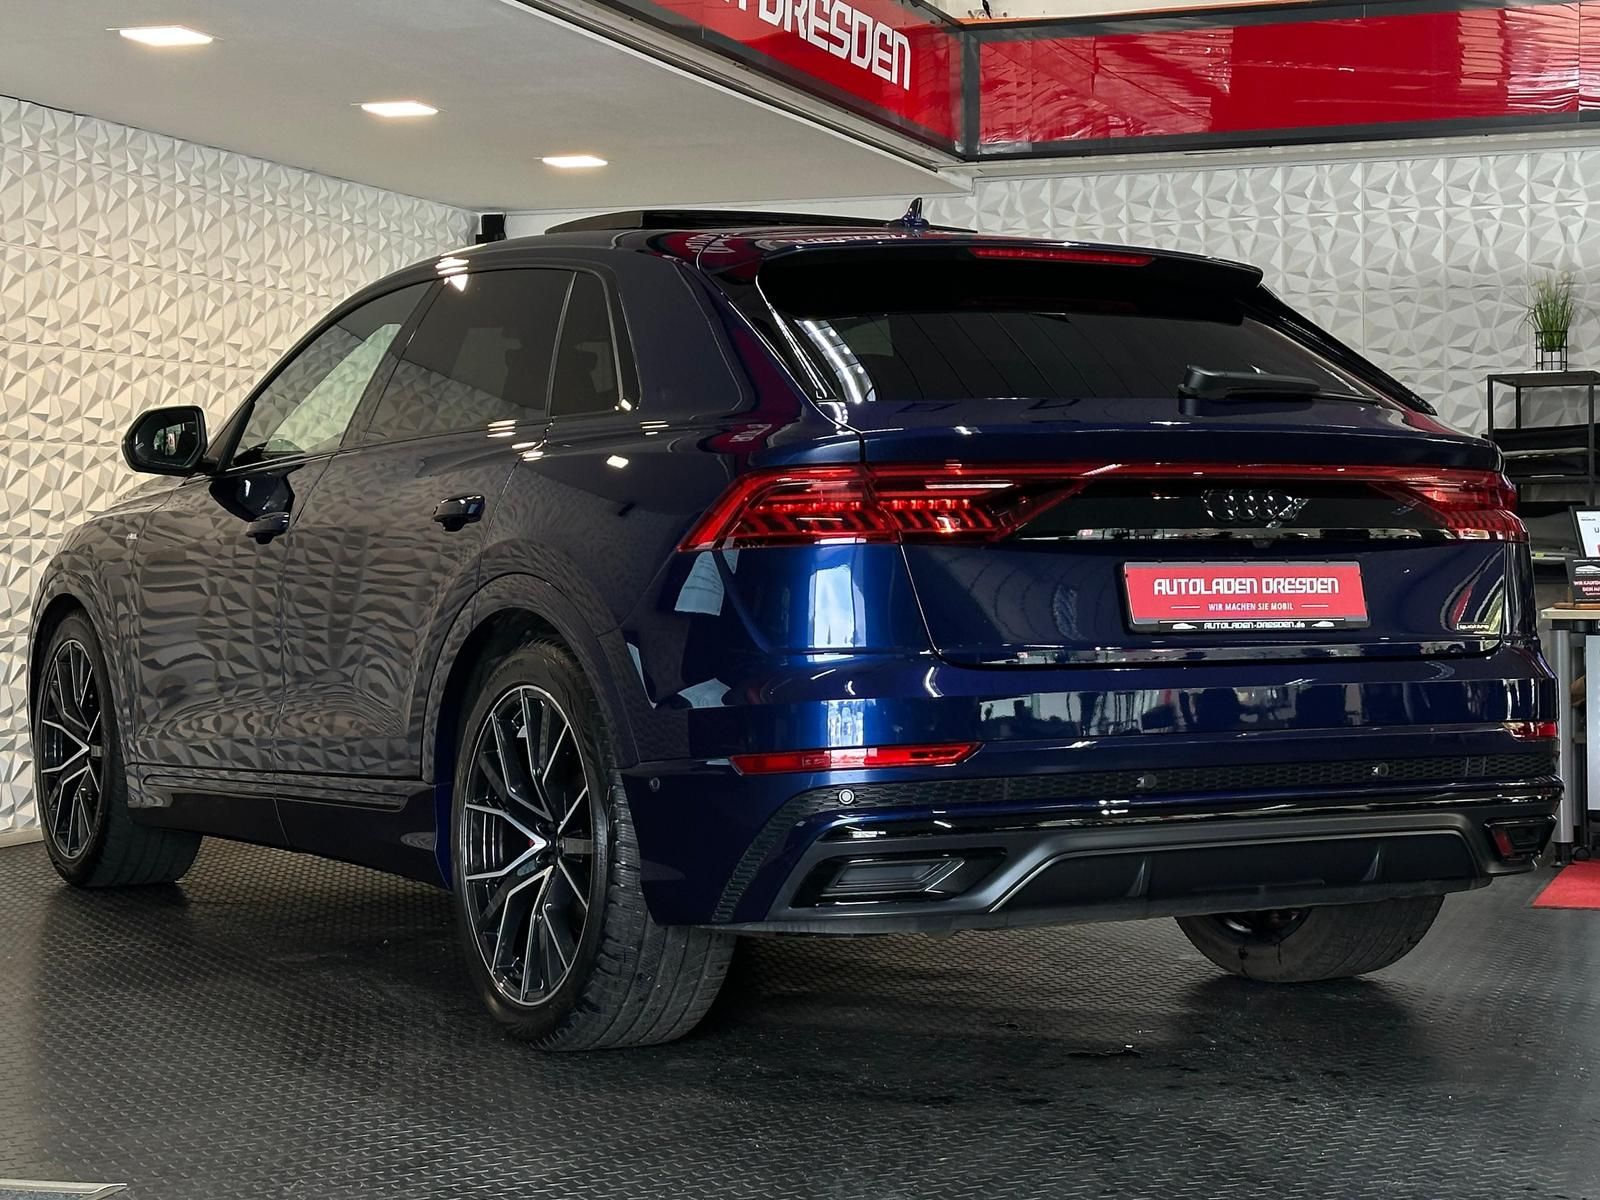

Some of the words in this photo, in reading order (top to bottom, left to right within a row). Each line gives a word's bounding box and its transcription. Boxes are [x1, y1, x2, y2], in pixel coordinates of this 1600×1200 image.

[1153, 577, 1258, 596] AUTOLADEN
[1261, 577, 1340, 595] DRESDEN
[1208, 603, 1223, 611] WIR
[1225, 603, 1256, 611] MACHEN
[1257, 602, 1269, 611] SIE
[1270, 602, 1294, 611] MOBIL
